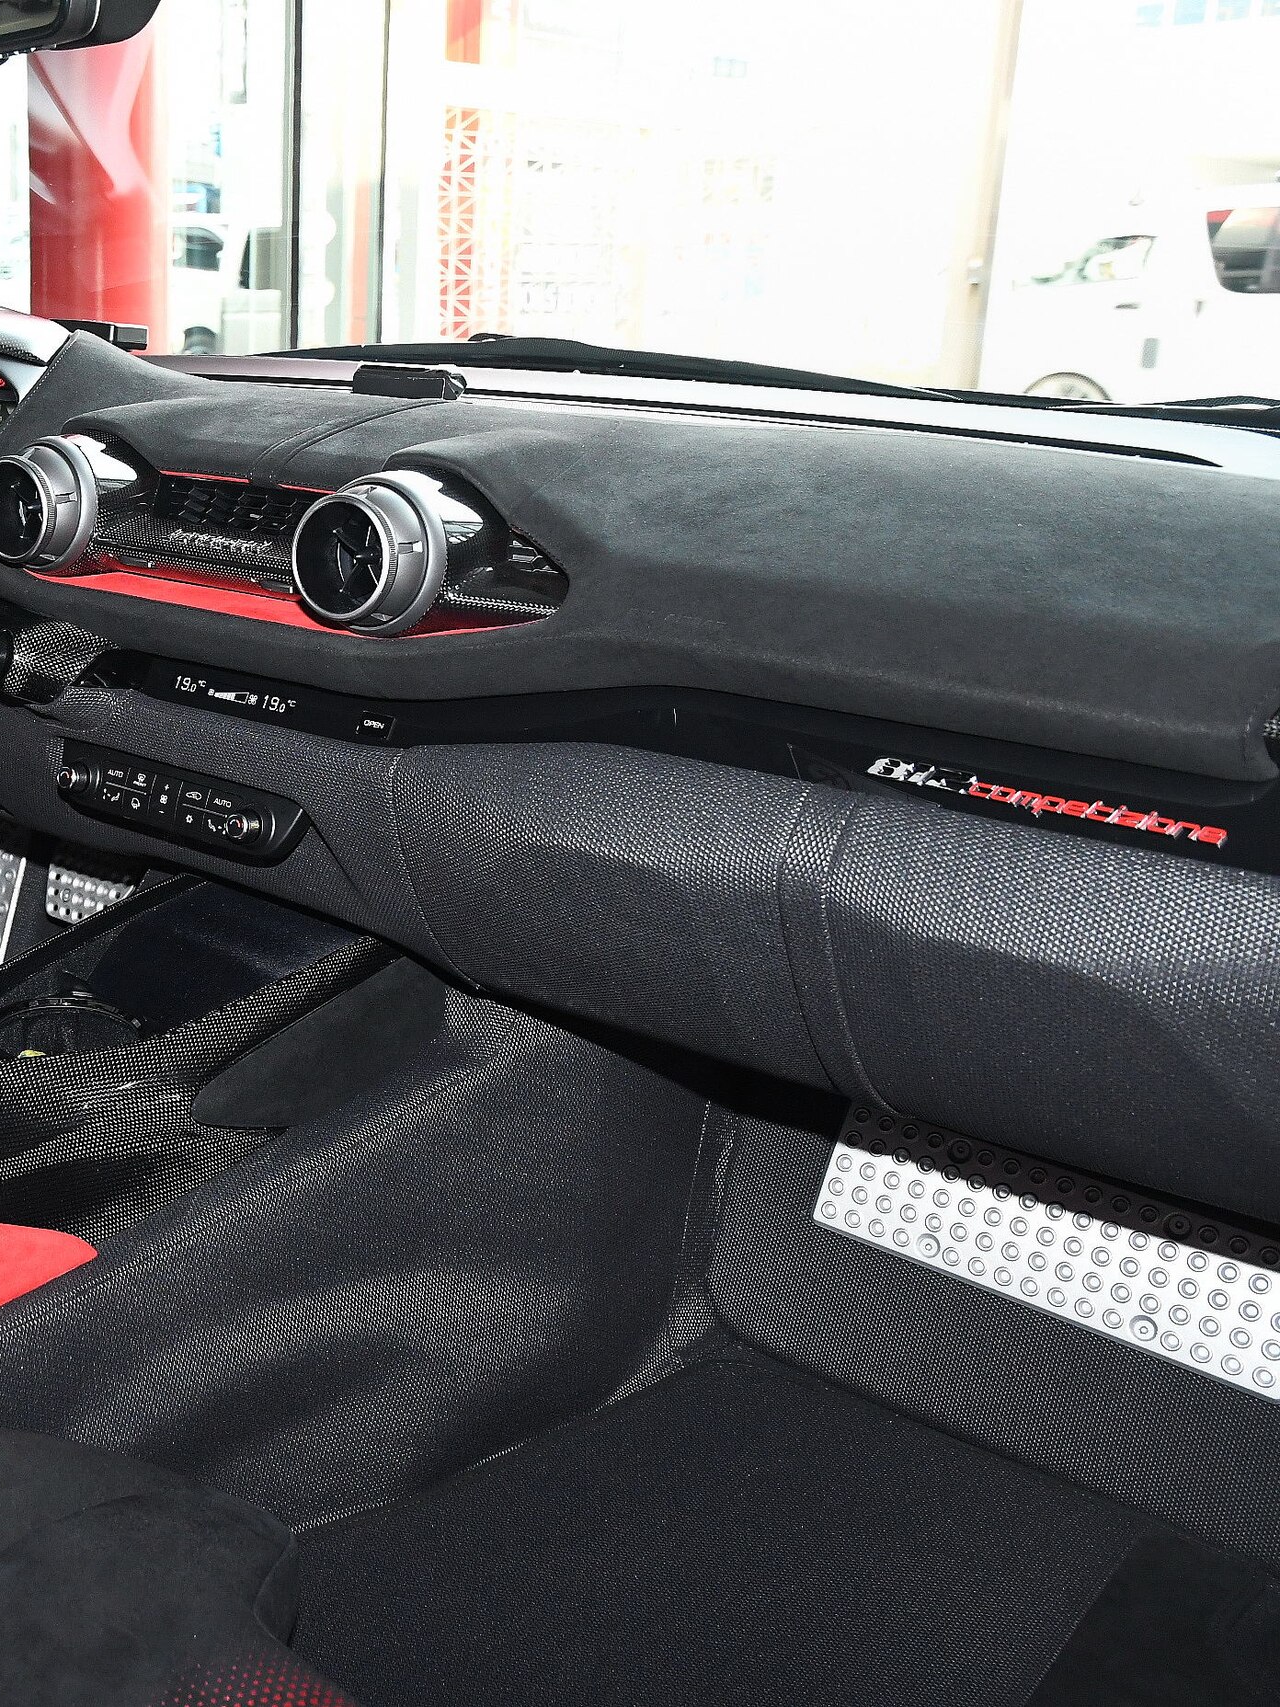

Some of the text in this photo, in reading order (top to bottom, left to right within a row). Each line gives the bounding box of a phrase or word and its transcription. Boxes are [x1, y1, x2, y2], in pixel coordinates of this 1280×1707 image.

[363, 719, 385, 730] OPEN
[107, 768, 124, 779] AUTO
[213, 797, 232, 809] AUTO
